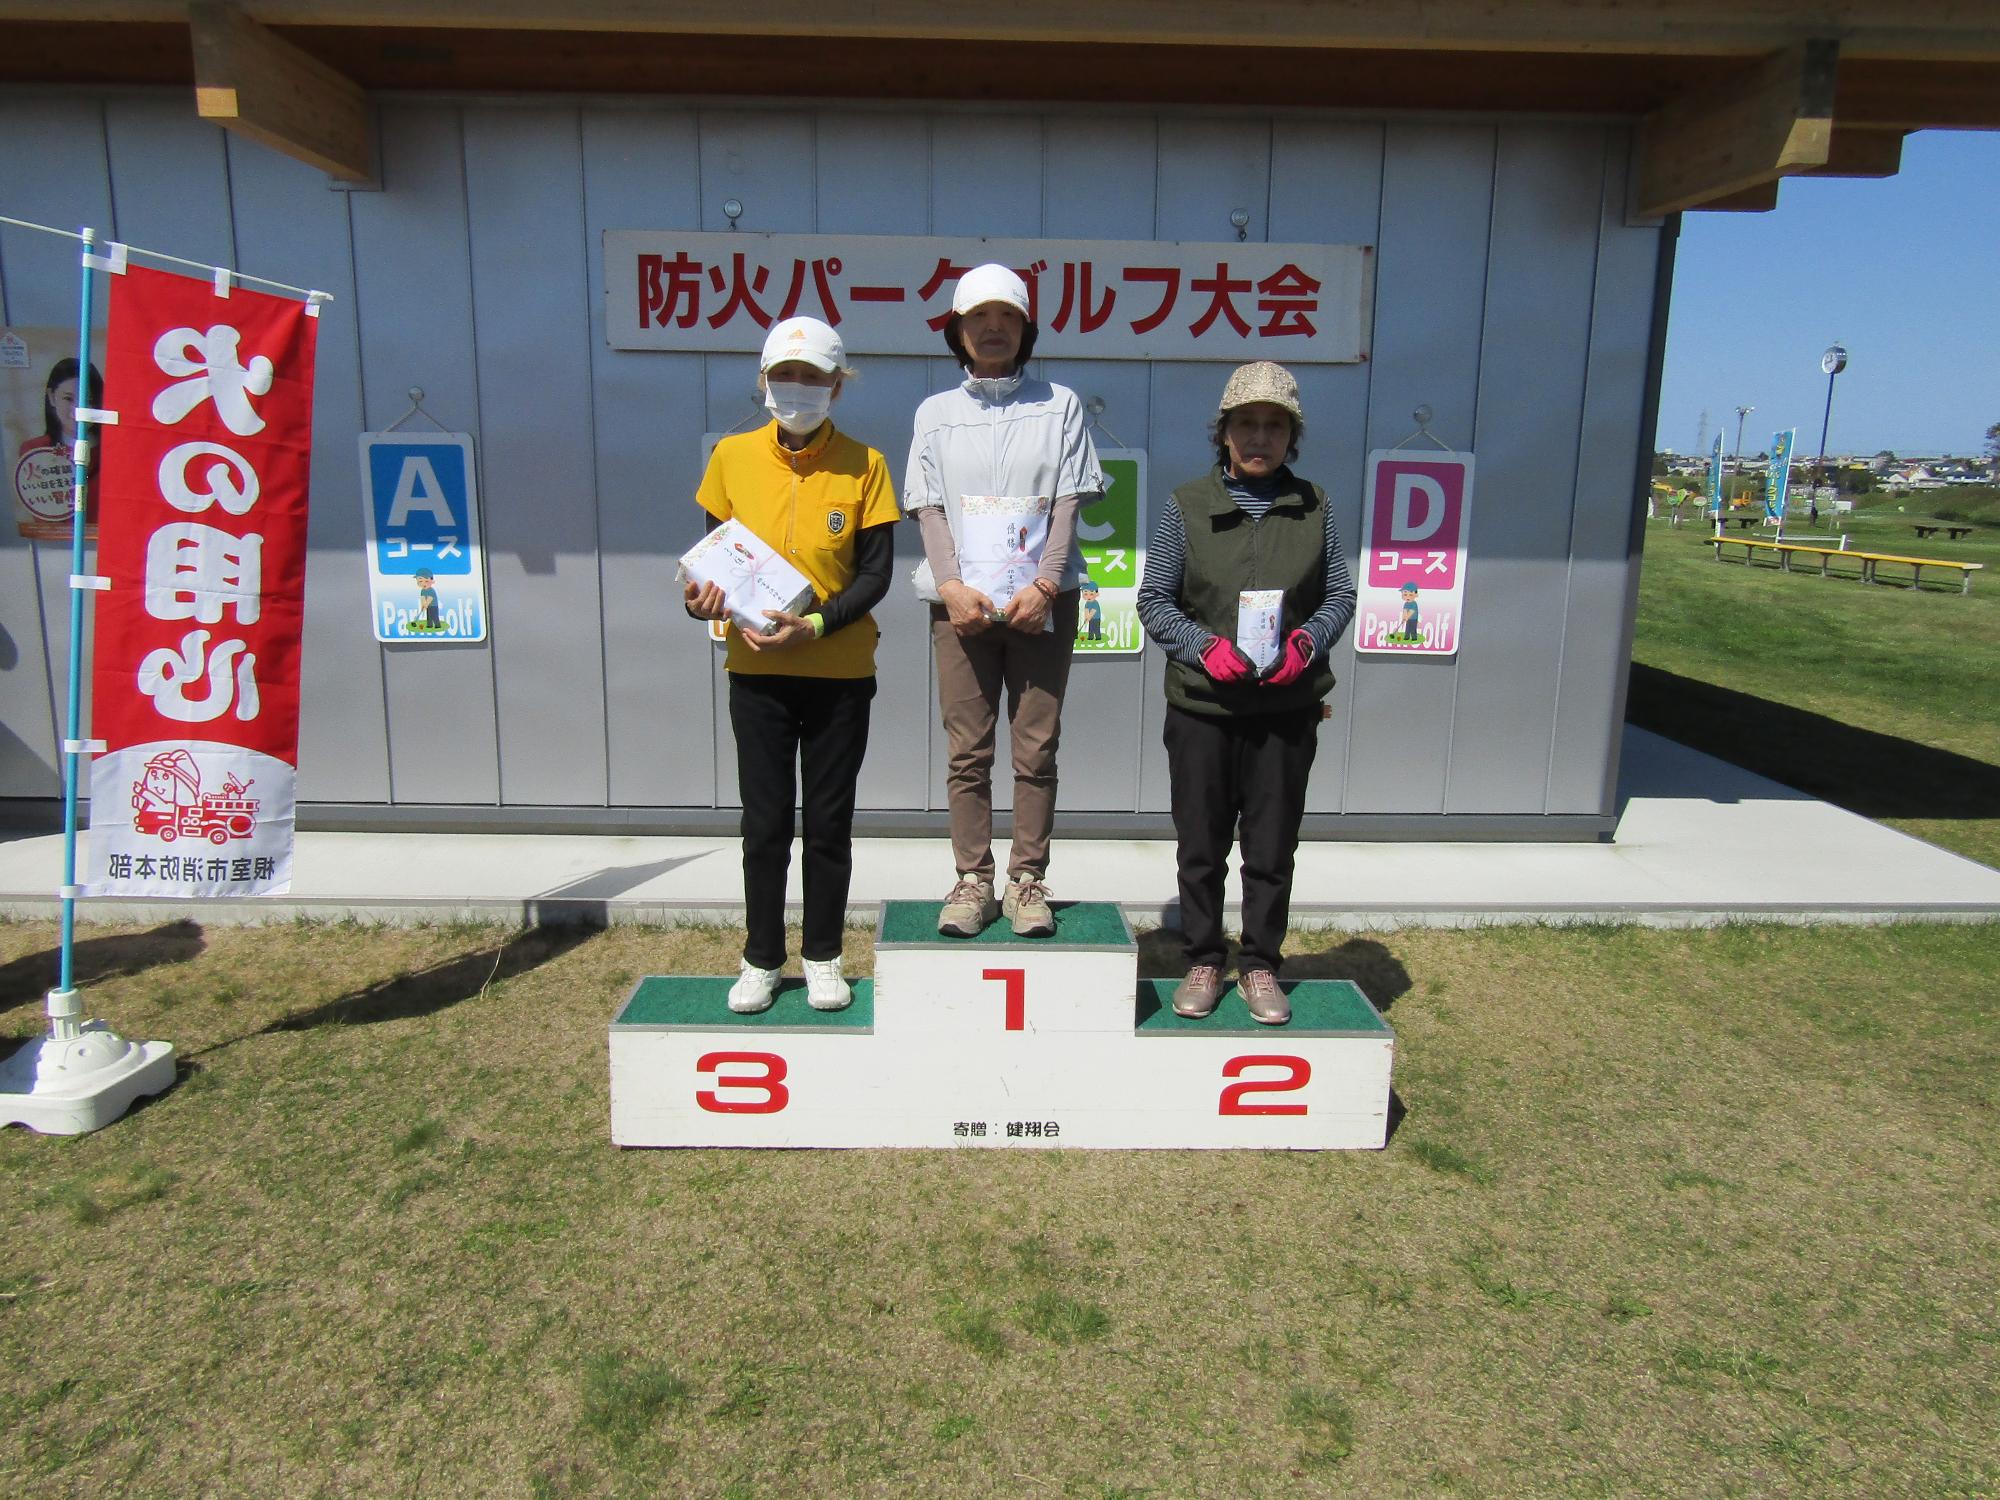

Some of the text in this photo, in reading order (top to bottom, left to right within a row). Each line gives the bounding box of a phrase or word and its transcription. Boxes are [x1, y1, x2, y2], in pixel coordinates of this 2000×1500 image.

[638, 252, 1321, 338] 防火パークゴルフ大会
[387, 456, 456, 526] A
[1391, 472, 1446, 542] D
[385, 535, 462, 559] コース
[1084, 549, 1128, 573] ース
[1378, 551, 1448, 574] コース
[982, 968, 1025, 1032] 1
[696, 1051, 790, 1114] 3
[1218, 1055, 1311, 1115] 2
